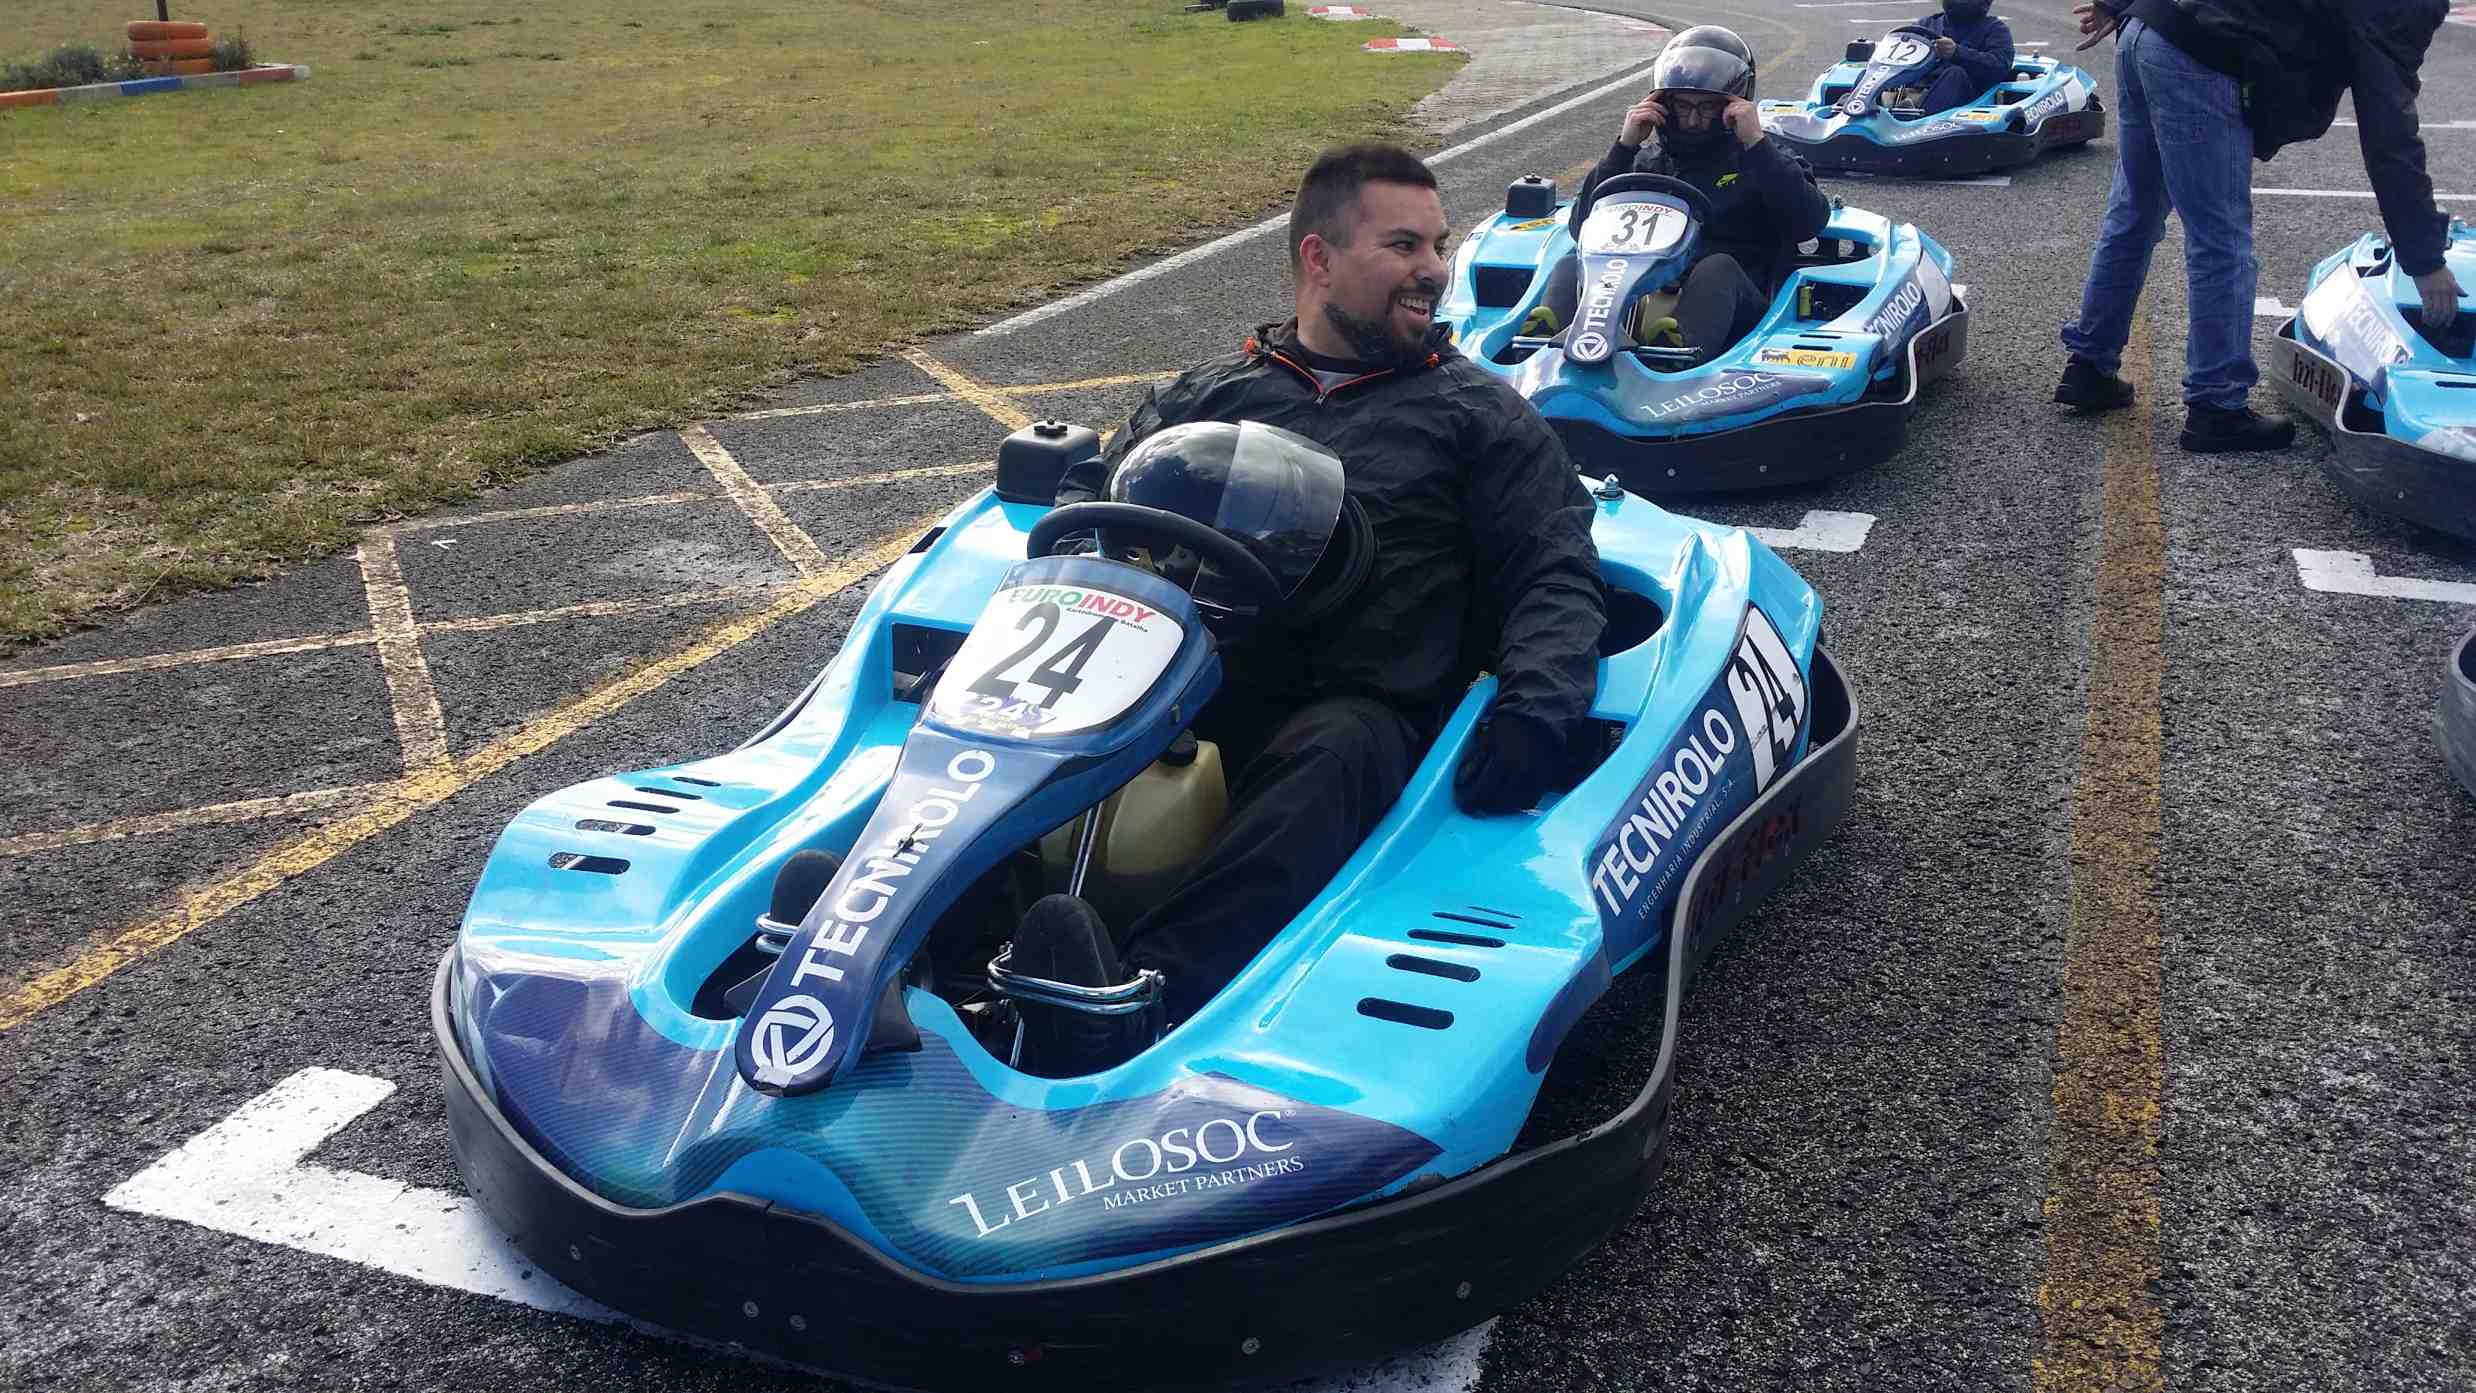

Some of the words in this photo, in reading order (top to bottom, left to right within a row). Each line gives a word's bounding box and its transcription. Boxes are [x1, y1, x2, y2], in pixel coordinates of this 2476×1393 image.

[1887, 41, 1917, 61] 12
[1611, 209, 1660, 246] 31
[1871, 281, 1921, 340] CNIROLO
[1010, 587, 1155, 623] EUROINDY
[966, 602, 1120, 709] 24
[1735, 633, 1799, 770] 24
[1592, 708, 1736, 917] TECNIROLO
[790, 749, 996, 987] TECNIROLO
[949, 1110, 1294, 1239] LEILOSOC
[1103, 1180, 1190, 1210] MARKET
[1195, 1156, 1305, 1190] PARTNERS
